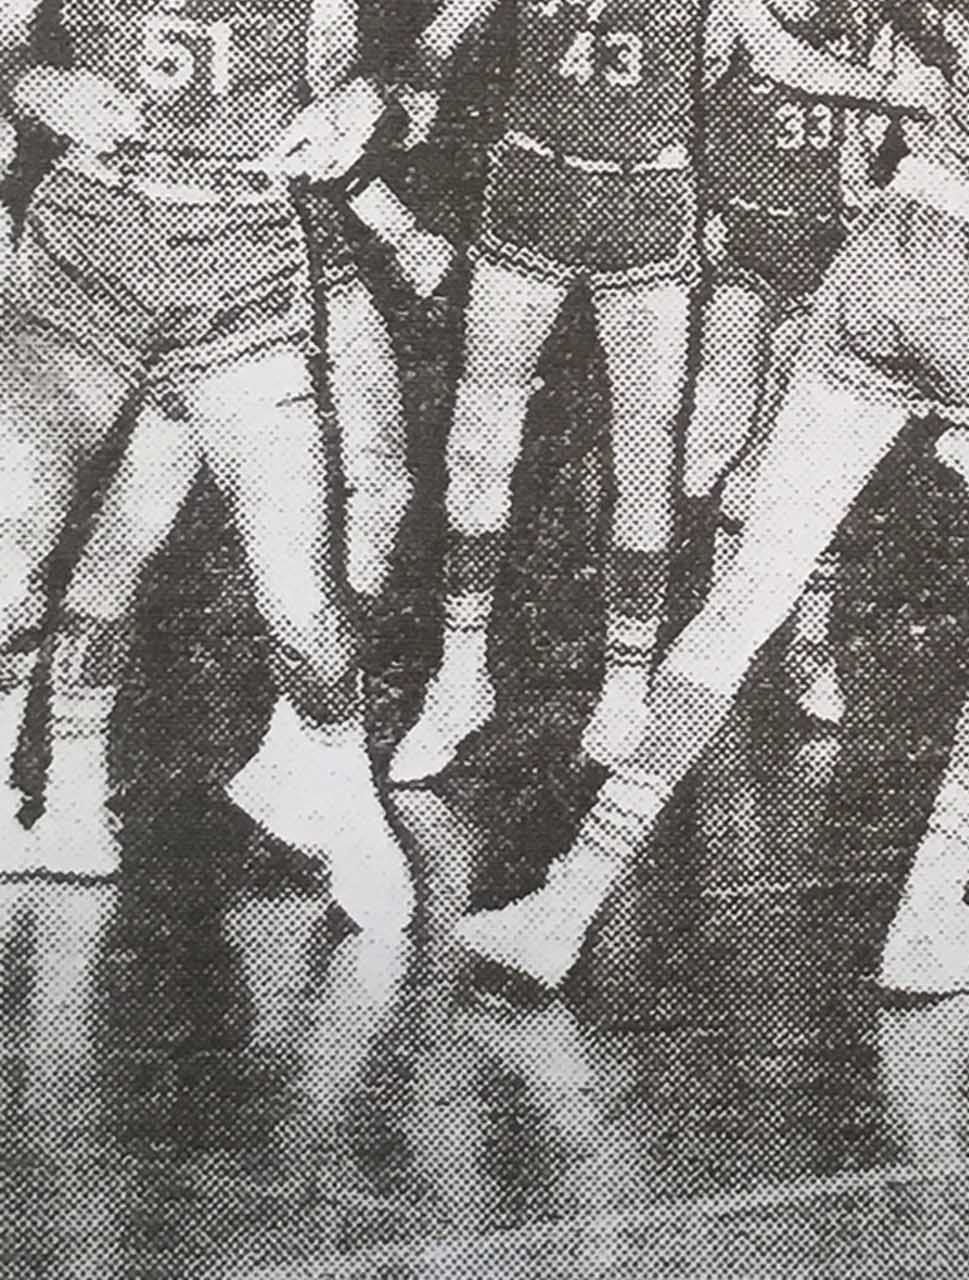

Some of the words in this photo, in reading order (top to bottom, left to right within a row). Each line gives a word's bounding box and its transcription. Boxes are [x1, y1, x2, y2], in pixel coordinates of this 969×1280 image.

[140, 16, 232, 96] 51
[558, 30, 642, 87] 43
[774, 102, 833, 150] 33
